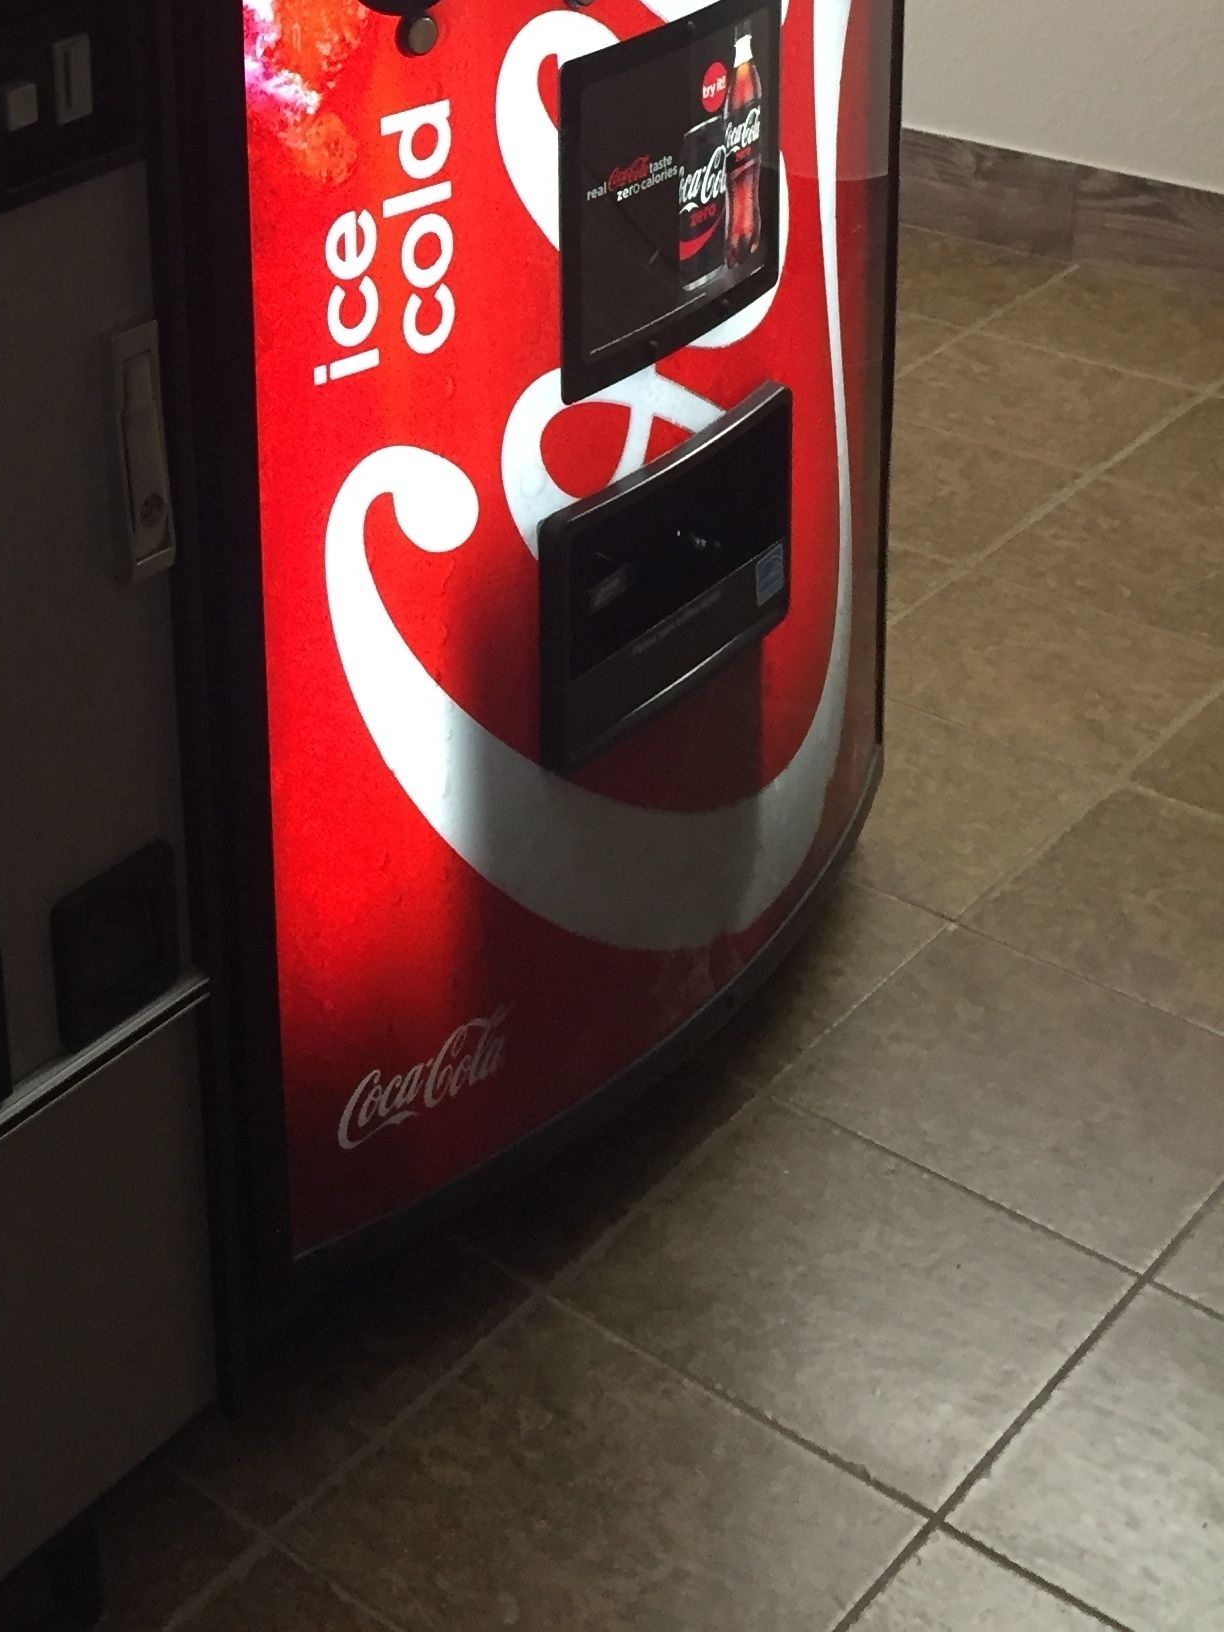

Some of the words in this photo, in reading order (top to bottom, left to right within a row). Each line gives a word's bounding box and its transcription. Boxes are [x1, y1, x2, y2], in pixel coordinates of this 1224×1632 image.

[380, 98, 456, 355] cold
[586, 180, 608, 202] real
[649, 155, 673, 174] taste
[616, 182, 641, 202] zero
[640, 165, 678, 191] calories
[689, 202, 718, 227] zero
[313, 208, 381, 386] ice
[337, 1000, 517, 1151] Coca-Cola
